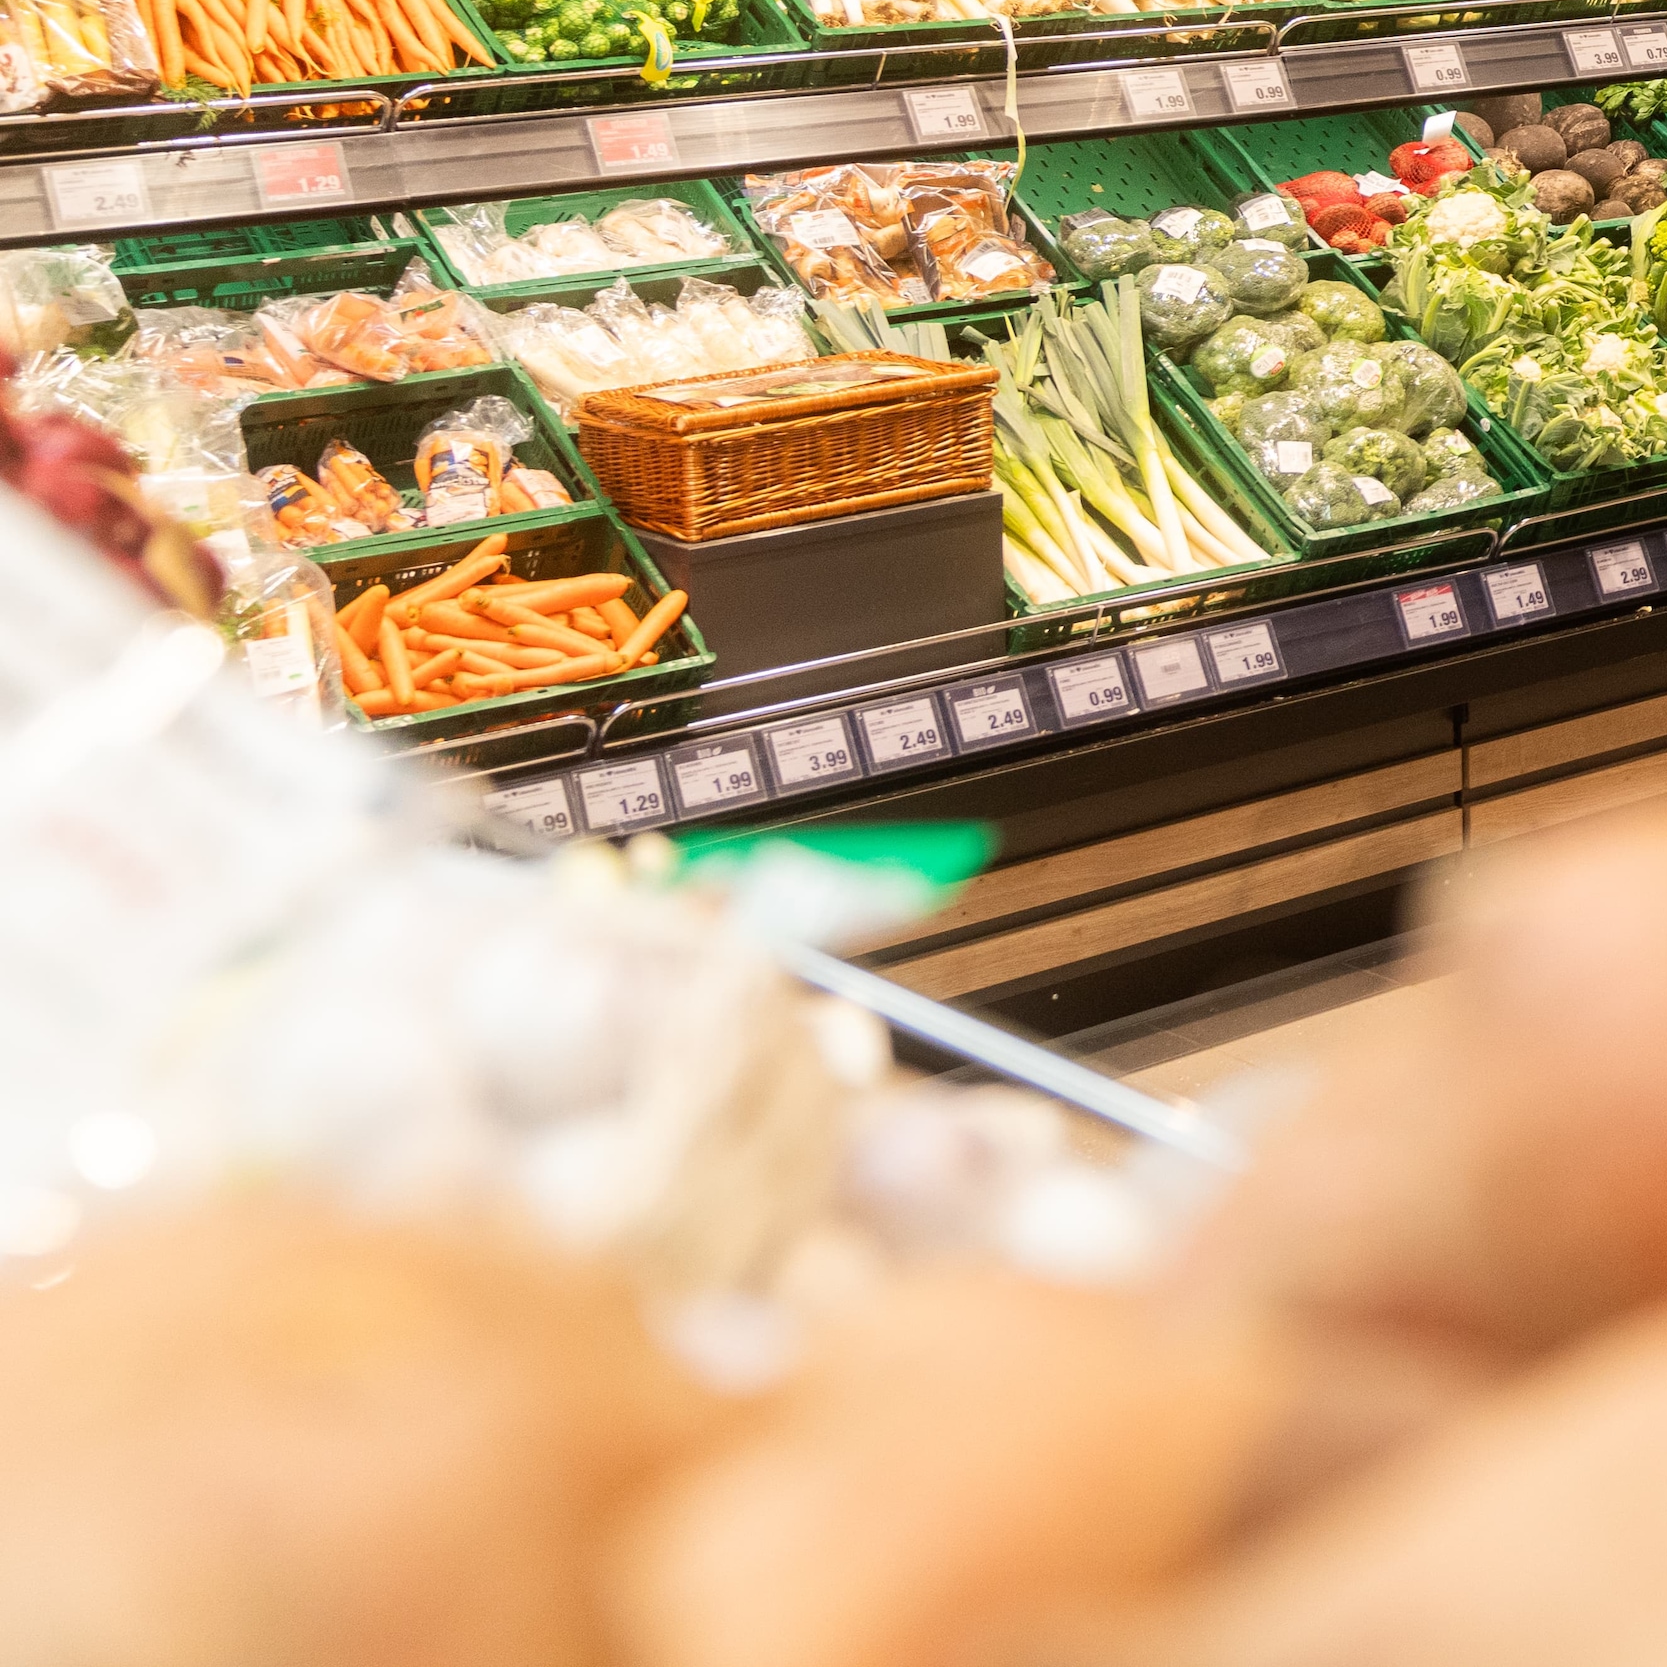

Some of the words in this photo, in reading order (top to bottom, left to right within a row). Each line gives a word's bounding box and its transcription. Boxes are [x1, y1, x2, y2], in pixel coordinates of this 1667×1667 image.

[1594, 52, 1619, 64] 3.99
[1435, 67, 1462, 81] 0.99
[1155, 95, 1185, 110] 1.99
[1255, 86, 1284, 101] 0.99
[943, 113, 976, 131] 1.99
[631, 143, 669, 160] 1.49
[297, 175, 342, 194] 1.29
[1620, 566, 1648, 584] 2.99
[1516, 590, 1544, 609] 1.49
[1429, 609, 1458, 629] 1.99
[1242, 651, 1275, 671] 1.99
[1089, 686, 1123, 706] 0.99
[987, 708, 1025, 730] 2.49
[899, 729, 938, 751] 2.49
[809, 749, 848, 772] 3.99
[712, 771, 753, 794] 1.99
[618, 793, 660, 815] 1.29
